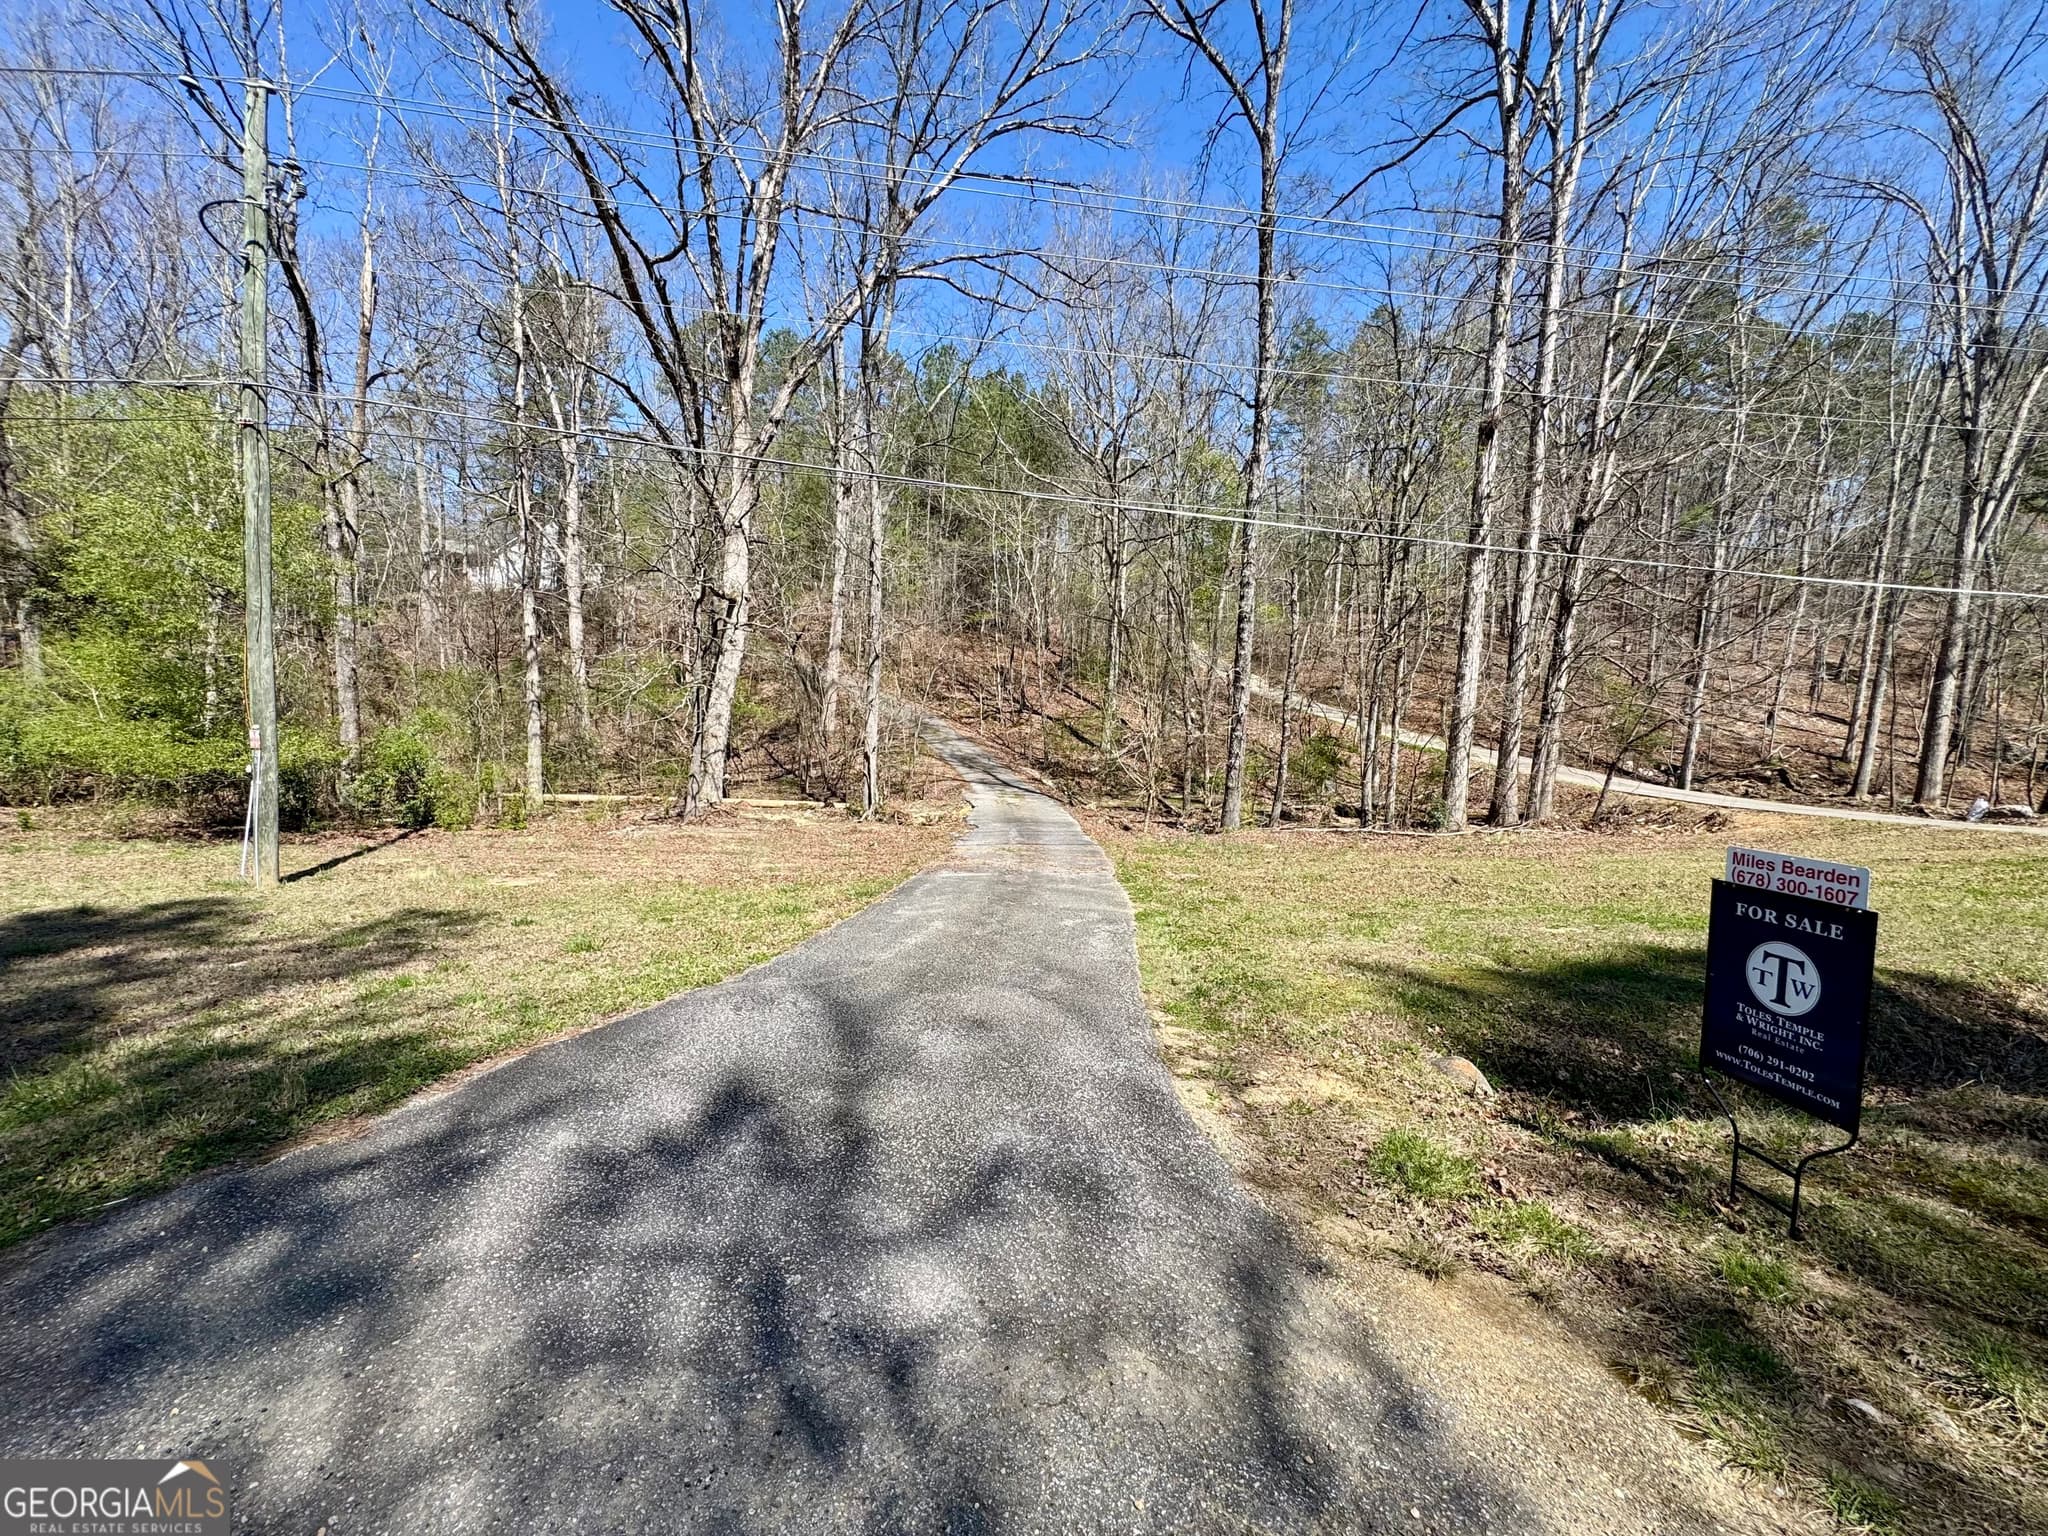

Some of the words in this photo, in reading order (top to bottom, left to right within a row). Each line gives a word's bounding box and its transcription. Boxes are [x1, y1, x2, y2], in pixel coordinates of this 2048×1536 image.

[1731, 867, 1771, 889] (678)
[1776, 877, 1859, 905] 300-1607
[1732, 851, 1775, 872] Miles
[1781, 860, 1860, 888] Bearden
[1736, 902, 1778, 925] FOR
[1784, 913, 1844, 940] SALE
[1736, 1013, 1744, 1022] &
[1799, 1035, 1823, 1052] INC.
[1751, 1027, 1771, 1041] Real
[1775, 1037, 1805, 1054] Estate
[1776, 1016, 1824, 1041] TEMPLE
[1738, 1044, 1764, 1062] (706)
[1766, 1055, 1815, 1082] 291-0202
